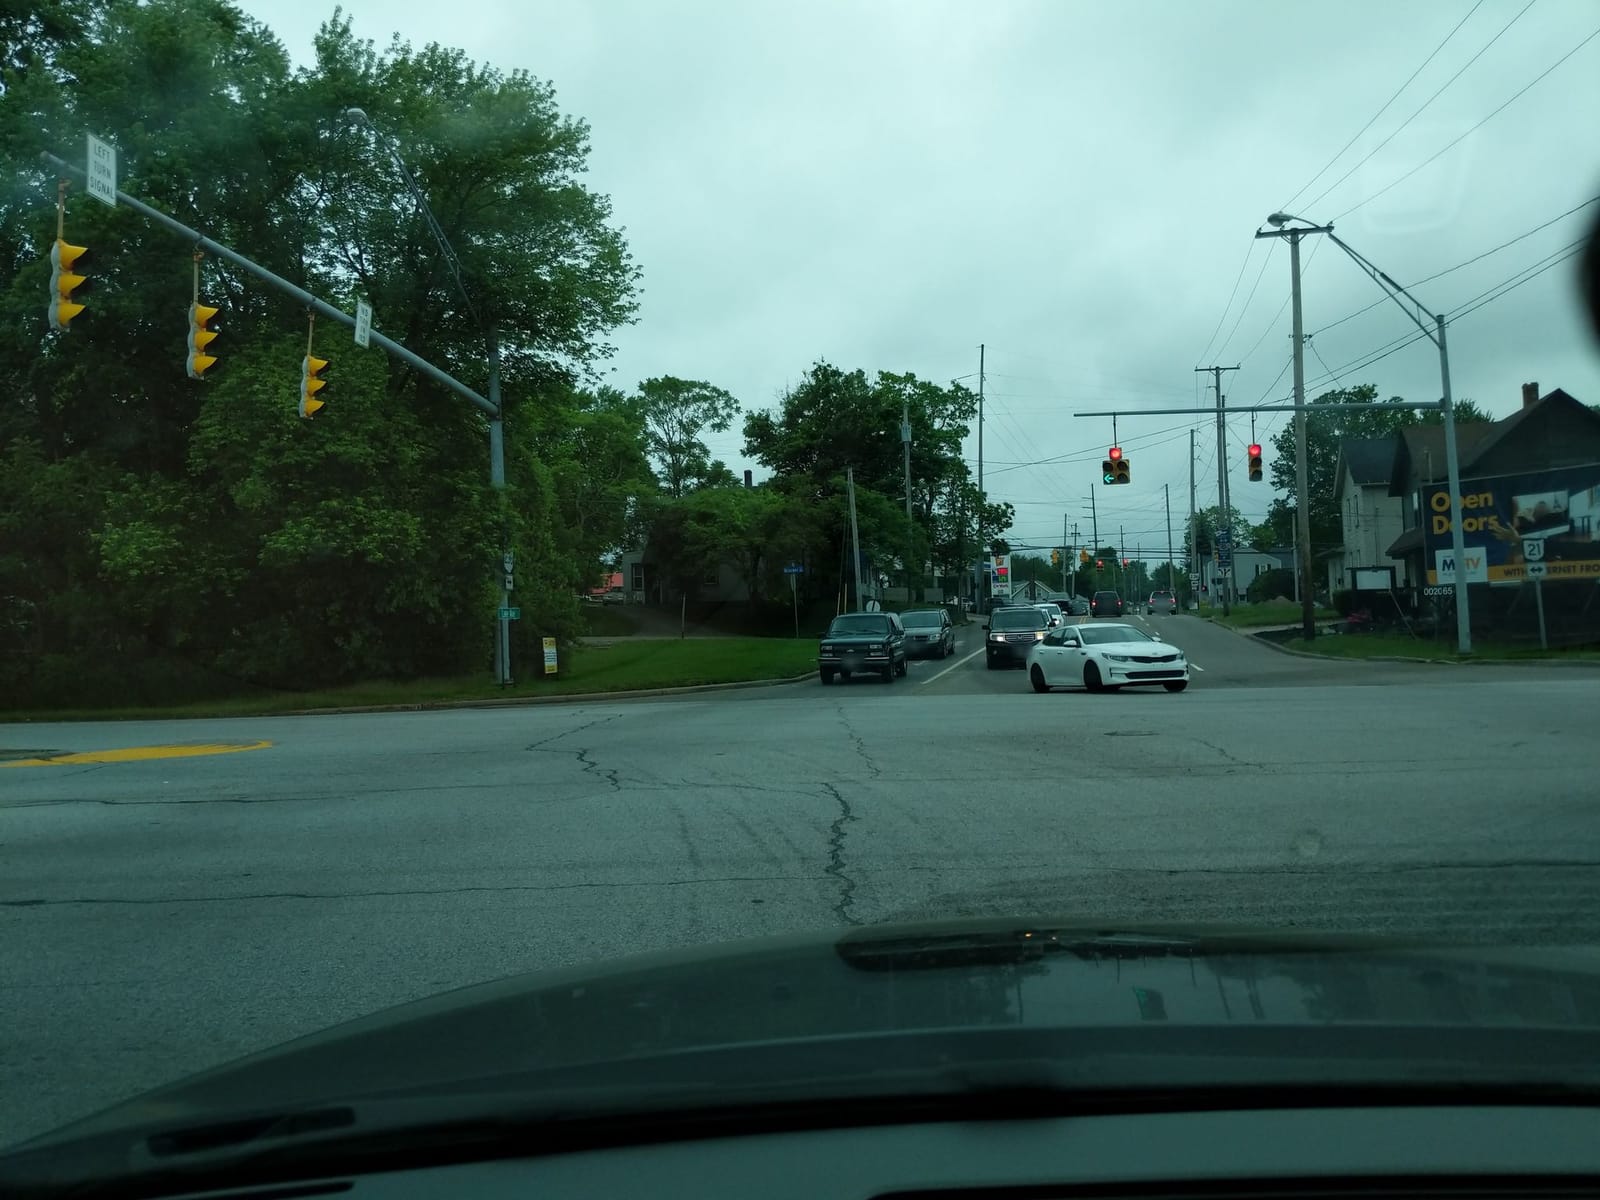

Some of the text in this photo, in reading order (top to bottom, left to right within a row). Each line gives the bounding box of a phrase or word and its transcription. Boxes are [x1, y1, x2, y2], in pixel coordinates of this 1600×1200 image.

[90, 176, 114, 199] SIGNAL
[1527, 543, 1542, 556] 21
[1442, 557, 1481, 571] MTV
